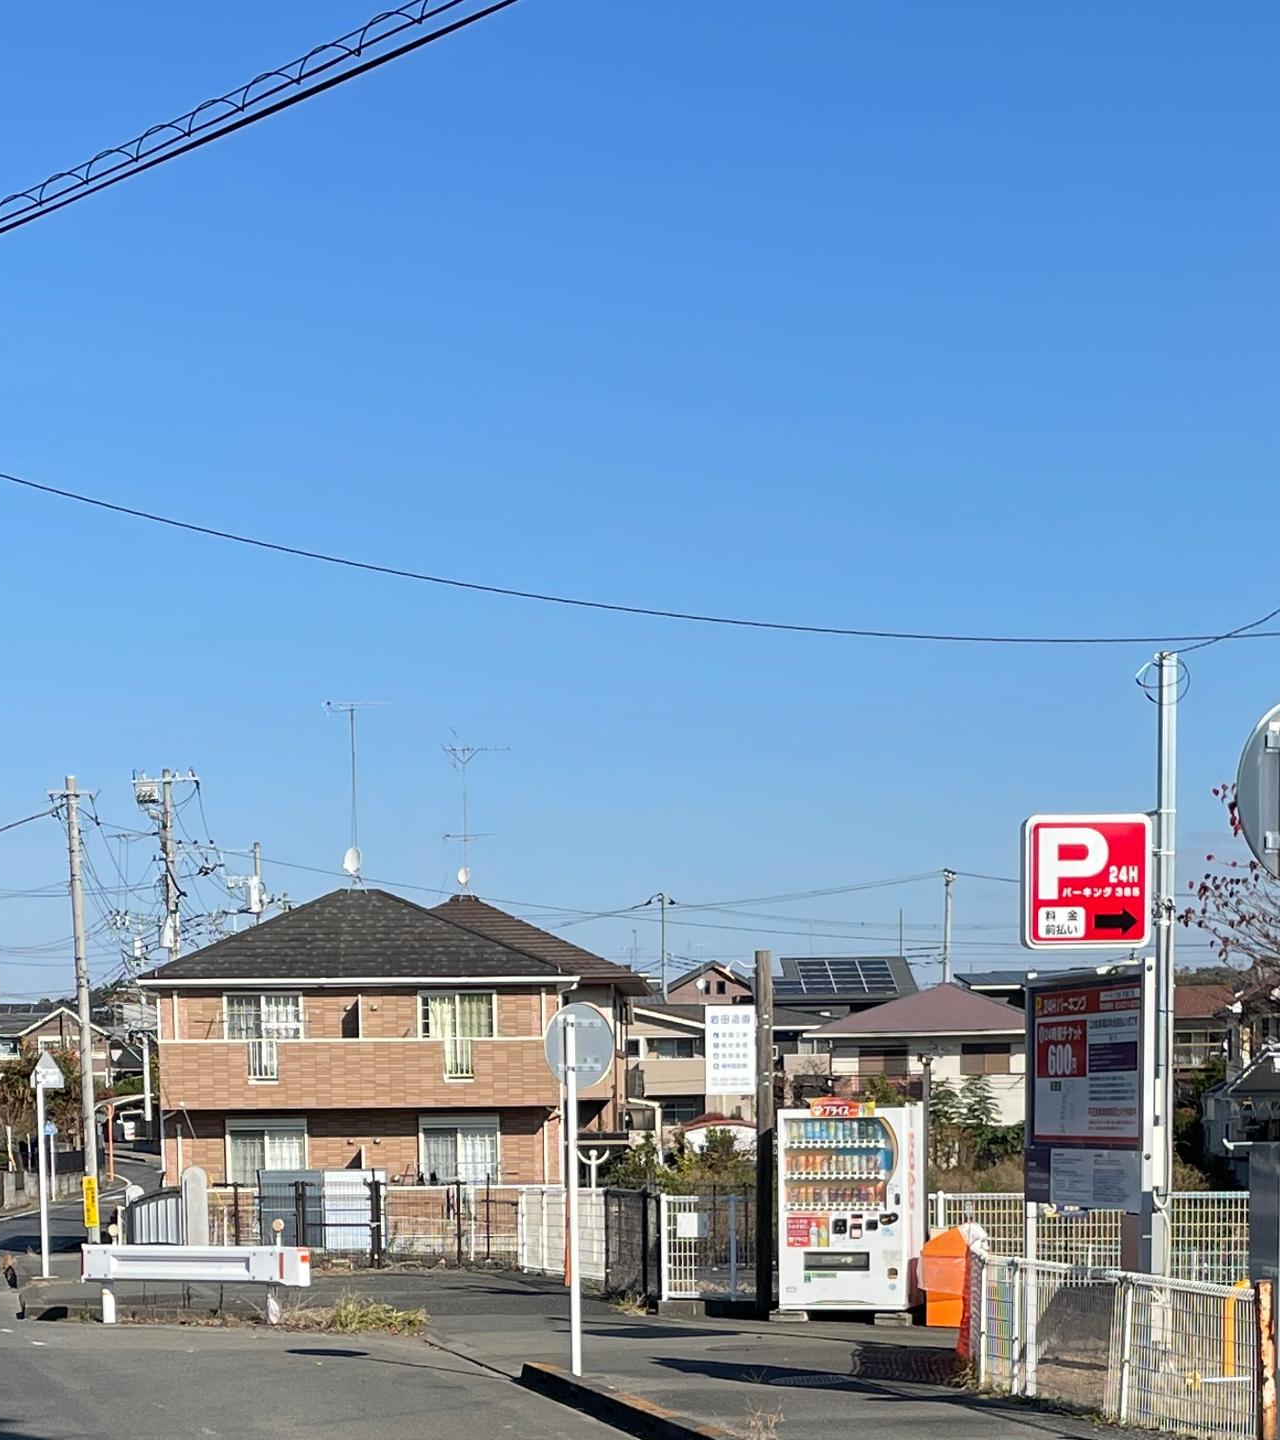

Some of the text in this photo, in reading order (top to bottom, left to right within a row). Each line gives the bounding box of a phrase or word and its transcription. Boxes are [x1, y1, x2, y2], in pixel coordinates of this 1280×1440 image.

[1038, 828, 1109, 900] P
[1109, 866, 1138, 883] 24H
[1062, 887, 1140, 898] パーキング 365
[1045, 910, 1078, 922] 料金
[1045, 924, 1078, 936] 前払い
